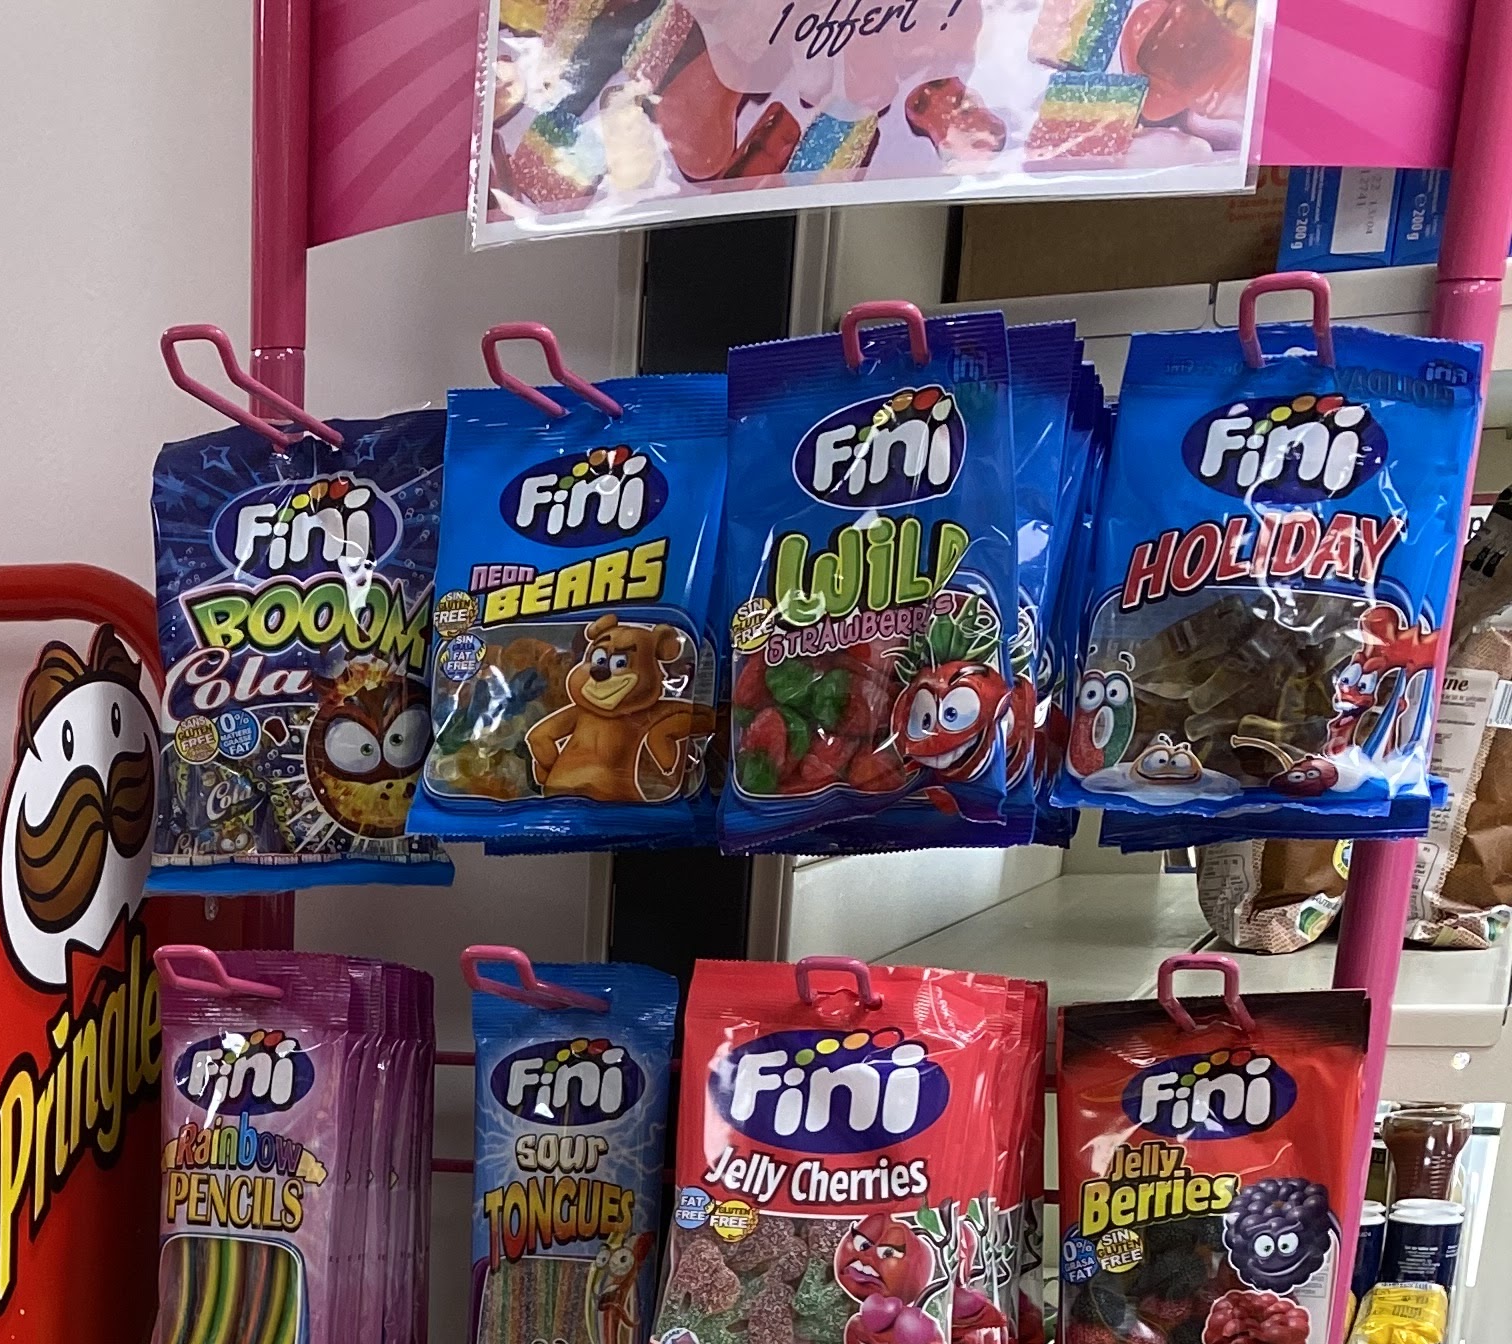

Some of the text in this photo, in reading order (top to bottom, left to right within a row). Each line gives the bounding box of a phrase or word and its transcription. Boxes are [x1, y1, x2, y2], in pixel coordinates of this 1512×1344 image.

[811, 385, 956, 497] Fini
[1199, 400, 1370, 498] Fini
[234, 488, 372, 572] Fini
[516, 454, 647, 535] Fini
[483, 538, 667, 625] BEARS
[1122, 514, 1405, 610] HOLIDAY
[163, 648, 312, 729] Cola
[186, 1036, 298, 1106] Fini
[505, 1046, 625, 1113] Fini
[729, 1043, 928, 1137] Fini
[1138, 1056, 1272, 1131] Fini
[175, 1111, 305, 1173] Rainbow
[705, 1145, 930, 1201] Jelly Cherries
[1109, 1140, 1185, 1183] Jelly
[166, 1172, 306, 1232] PENCILS
[483, 1175, 637, 1271] TONGUES
[680, 1194, 705, 1208] FAT
[710, 1213, 749, 1230] FREE
[1080, 1172, 1241, 1235] Berries
